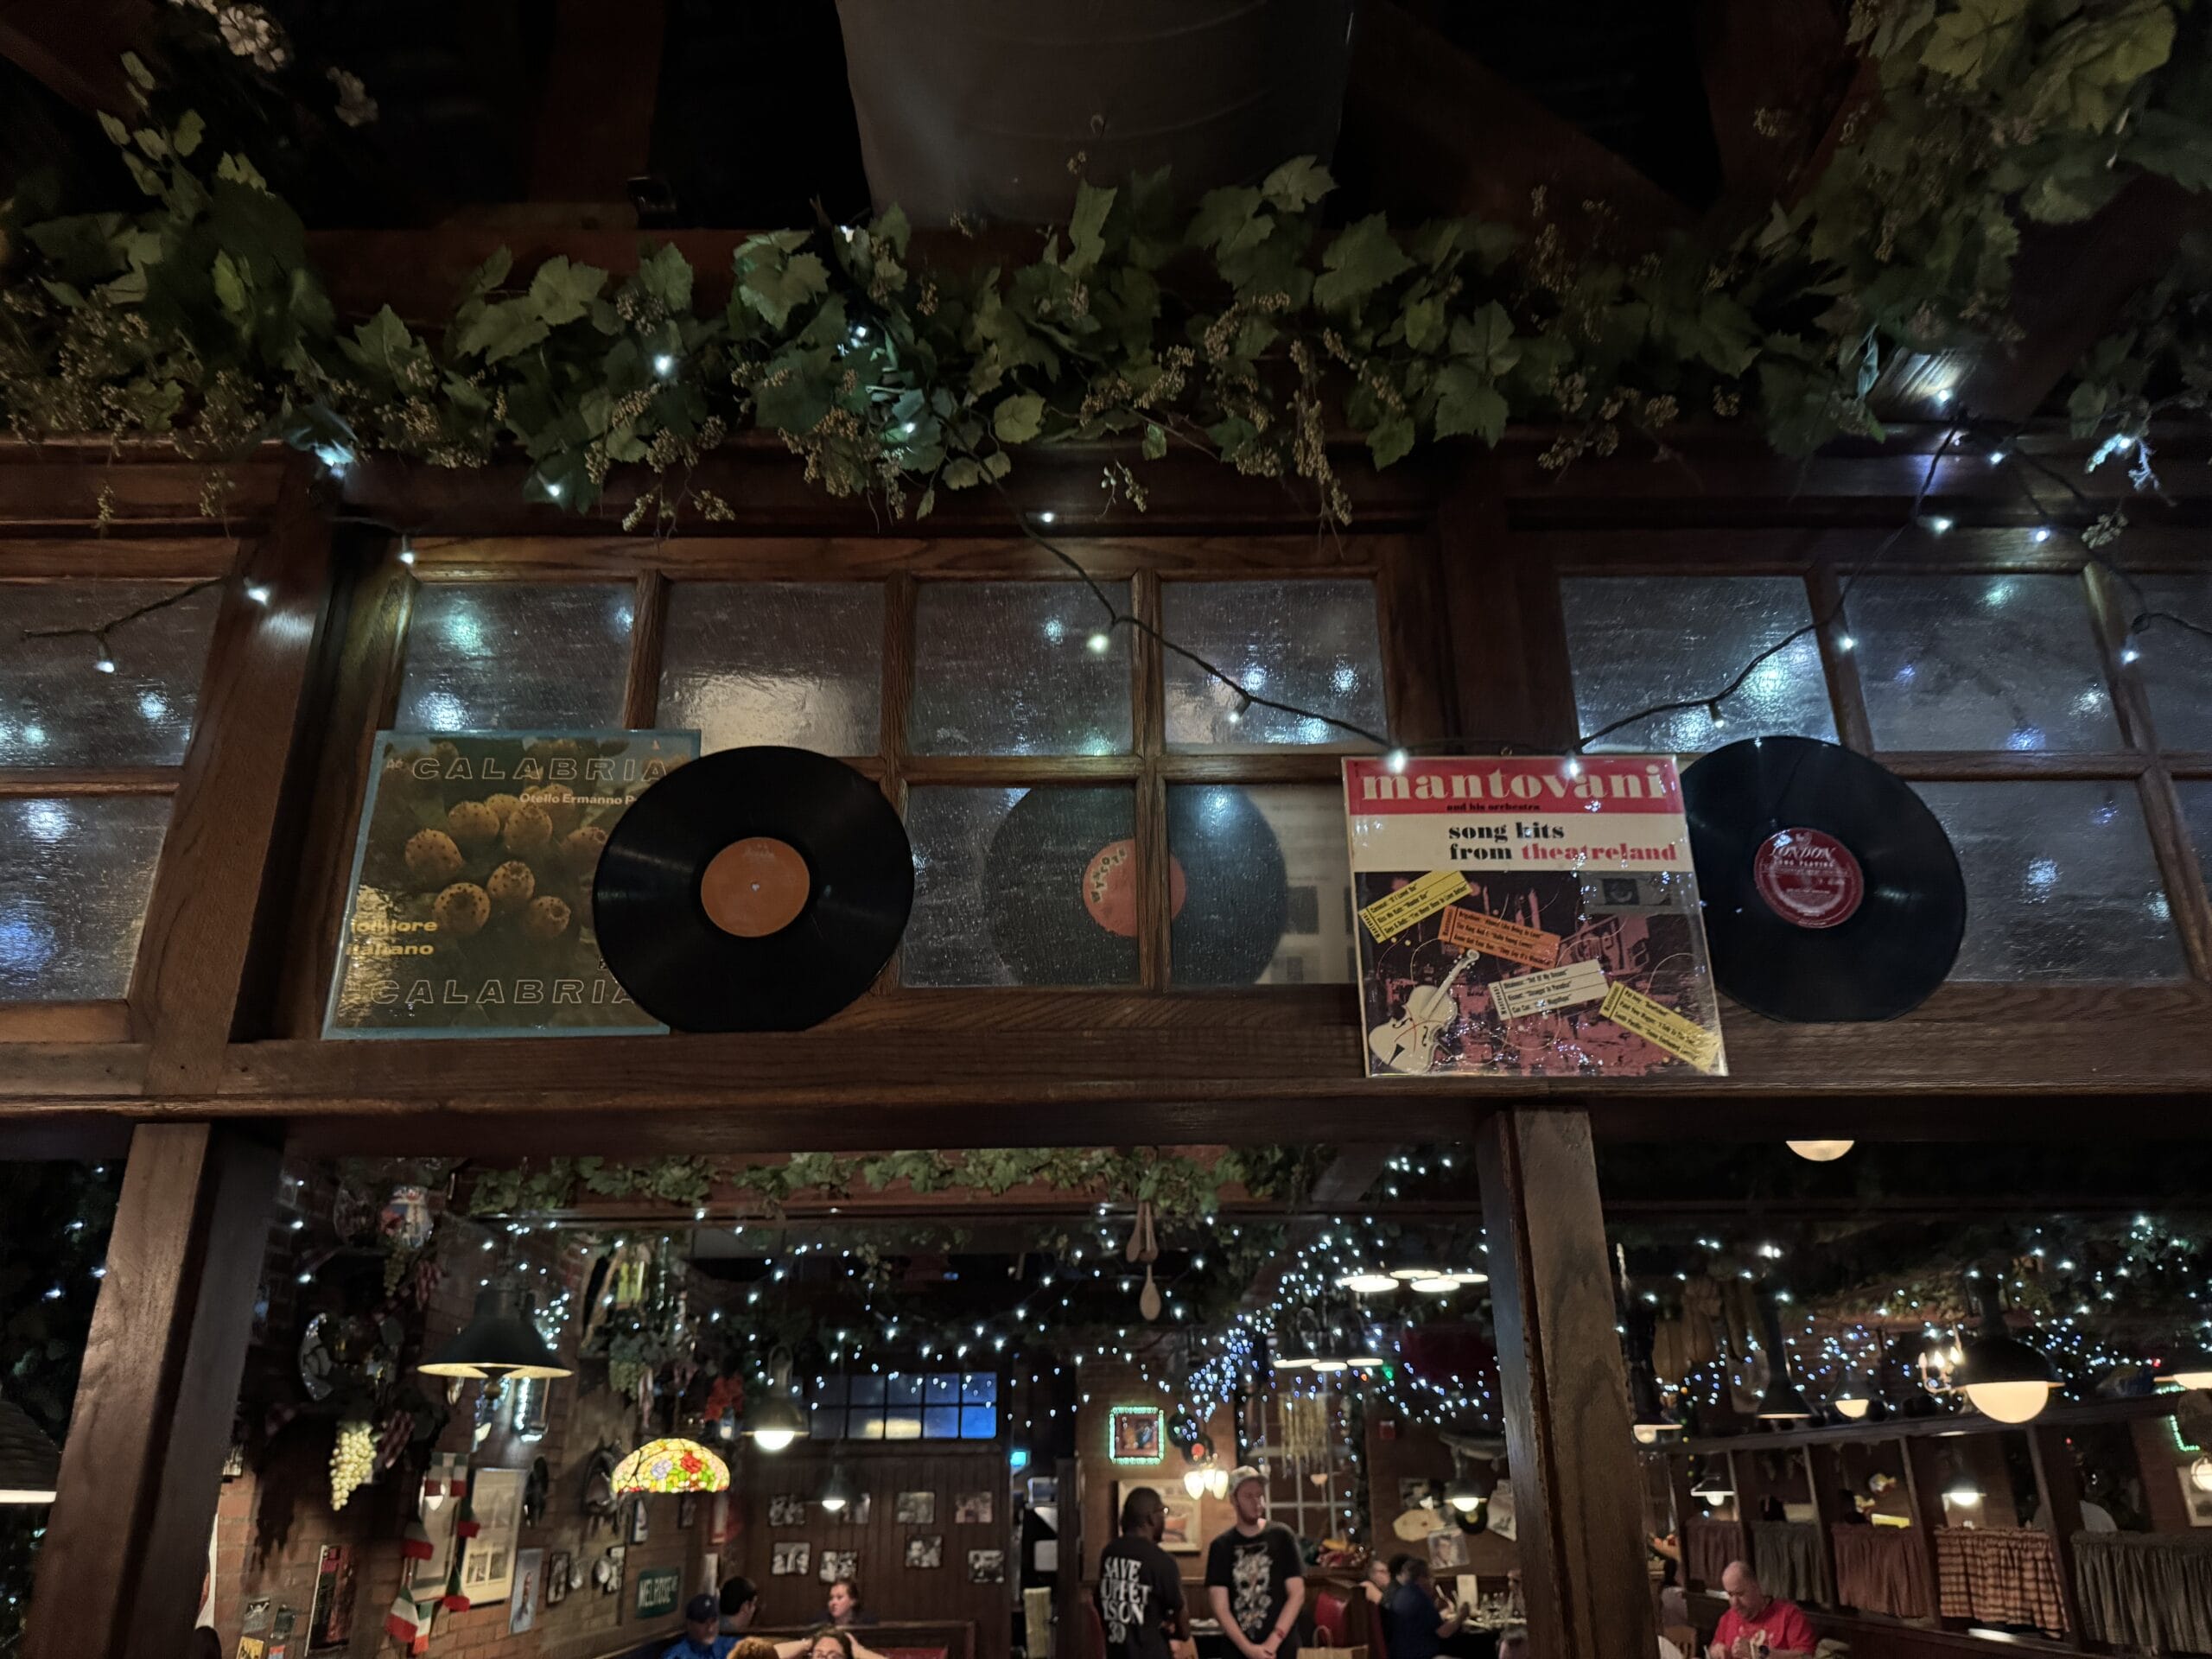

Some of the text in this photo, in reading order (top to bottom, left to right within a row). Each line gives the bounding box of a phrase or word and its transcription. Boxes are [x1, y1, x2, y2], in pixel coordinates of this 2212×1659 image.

[413, 758, 667, 781] CALABRIA
[1363, 764, 1668, 800] mantovani
[519, 793, 560, 804] Otello
[563, 793, 623, 805] Ermanno
[1487, 803, 1541, 811] orchestra
[1448, 821, 1566, 843] song hits
[1449, 843, 1678, 862] from theatreland
[1770, 845, 1837, 861] LONDON
[346, 944, 435, 956] italiano
[372, 979, 637, 1004] CALABRIA
[1103, 1556, 1142, 1582] SAVE
[638, 1576, 671, 1609] MELROSE
[1099, 1578, 1154, 1605] UPPET
